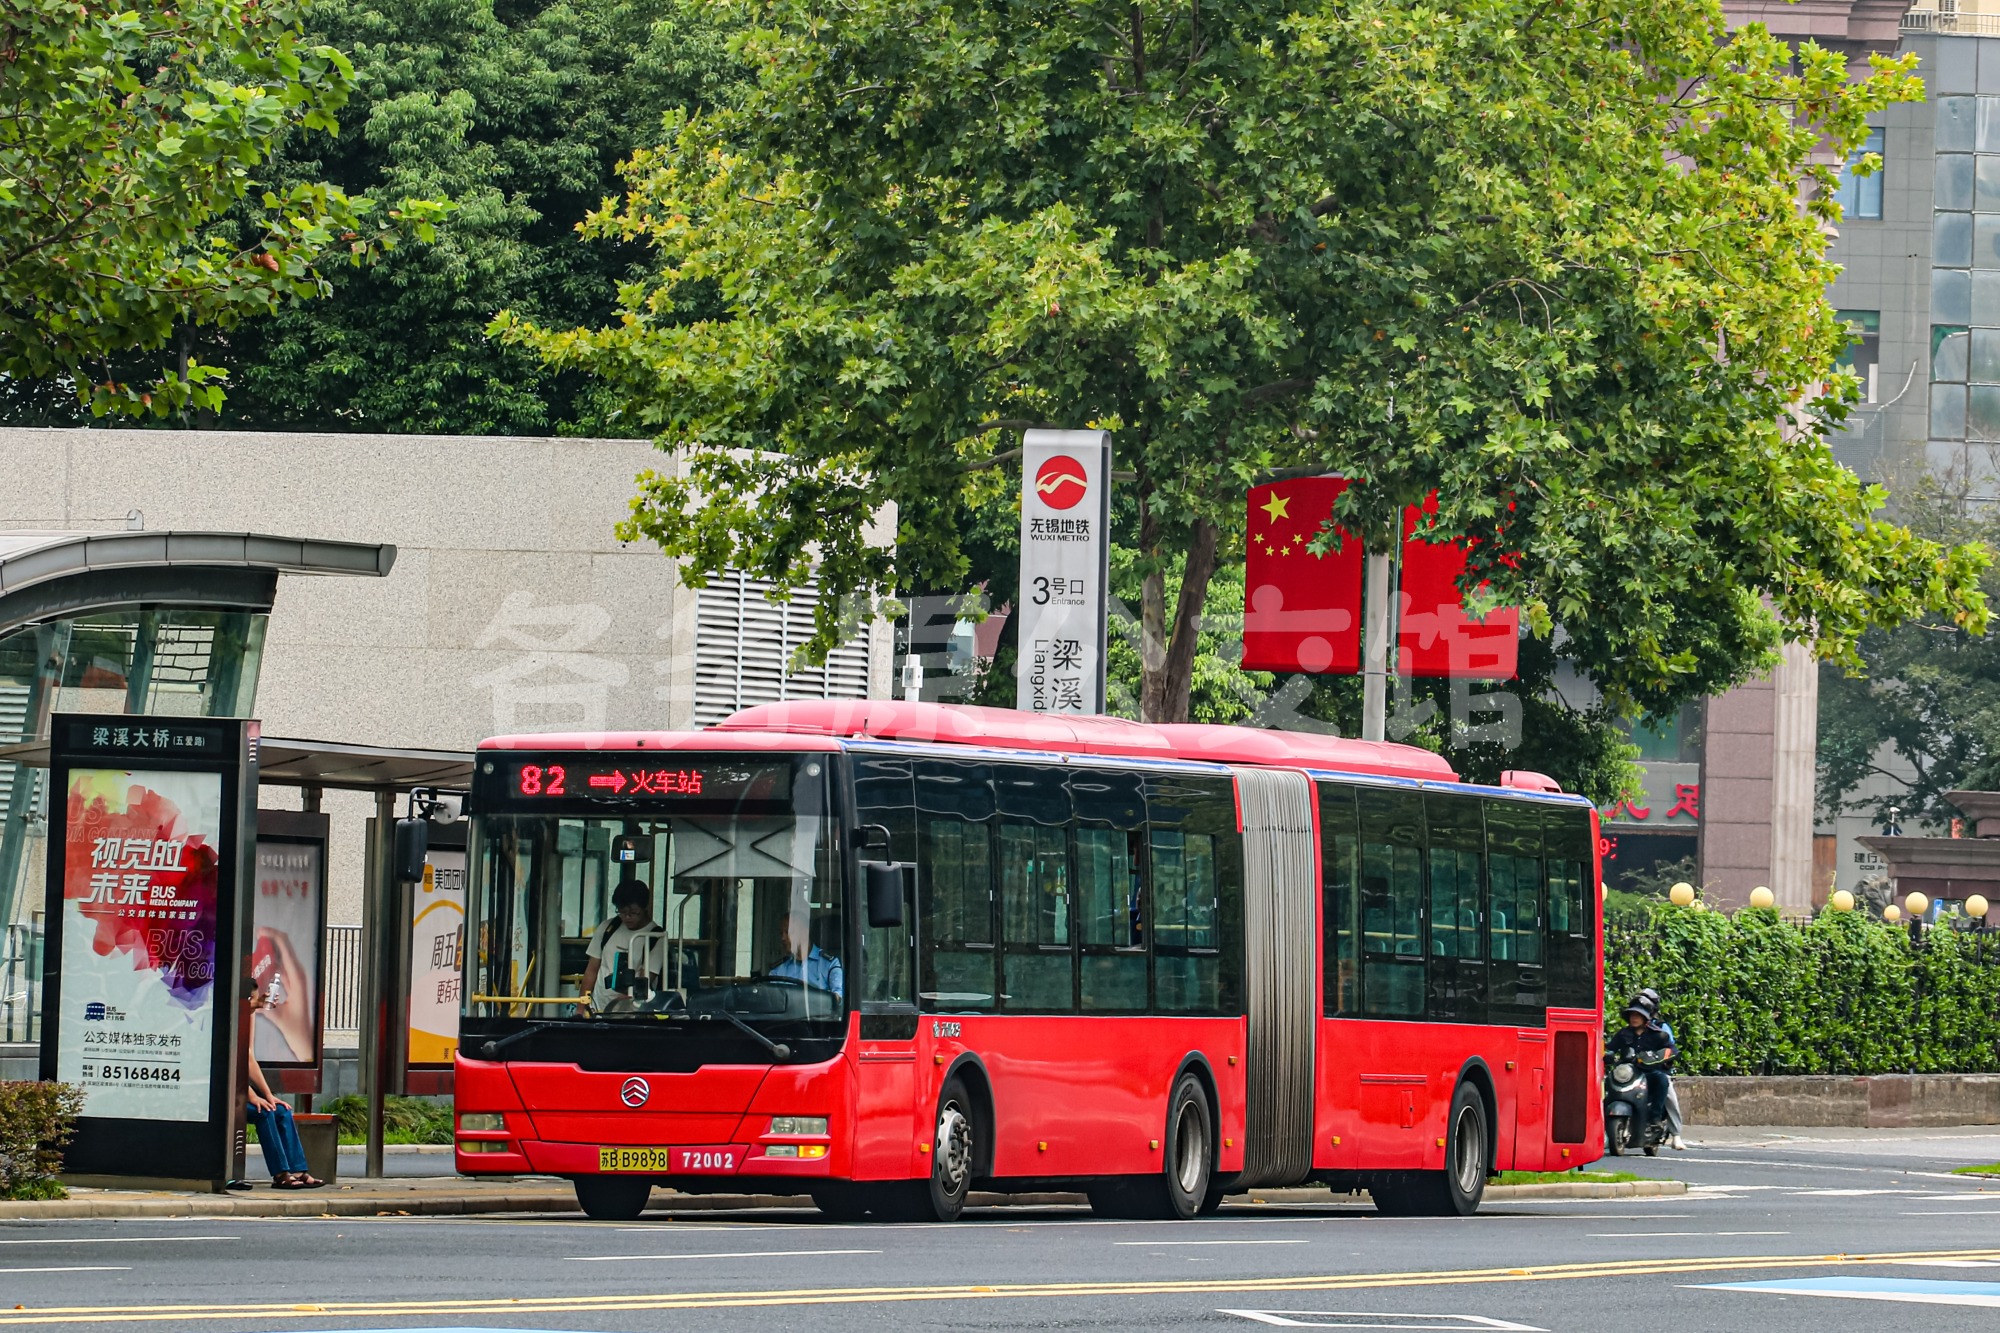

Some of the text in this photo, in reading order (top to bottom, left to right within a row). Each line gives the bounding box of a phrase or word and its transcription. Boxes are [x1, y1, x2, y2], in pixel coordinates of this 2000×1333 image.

[1030, 518, 1090, 534] 无锡地铁
[1051, 596, 1085, 606] Entrance
[1052, 638, 1083, 710] 梁溪
[520, 765, 702, 795] 82 火车站
[91, 837, 187, 872] 视觉的
[1854, 852, 1885, 863] 建行
[77, 872, 152, 905] 未来
[150, 886, 177, 899] BUS
[149, 898, 198, 908] MEDIA COMPANY
[118, 909, 197, 920] 公交媒体独家运营
[145, 928, 205, 960] BUS
[430, 930, 463, 971] 周五
[83, 1030, 182, 1047] 公交媒体独家发布
[102, 1065, 181, 1082] 85168484
[682, 1152, 733, 1169] 72002
